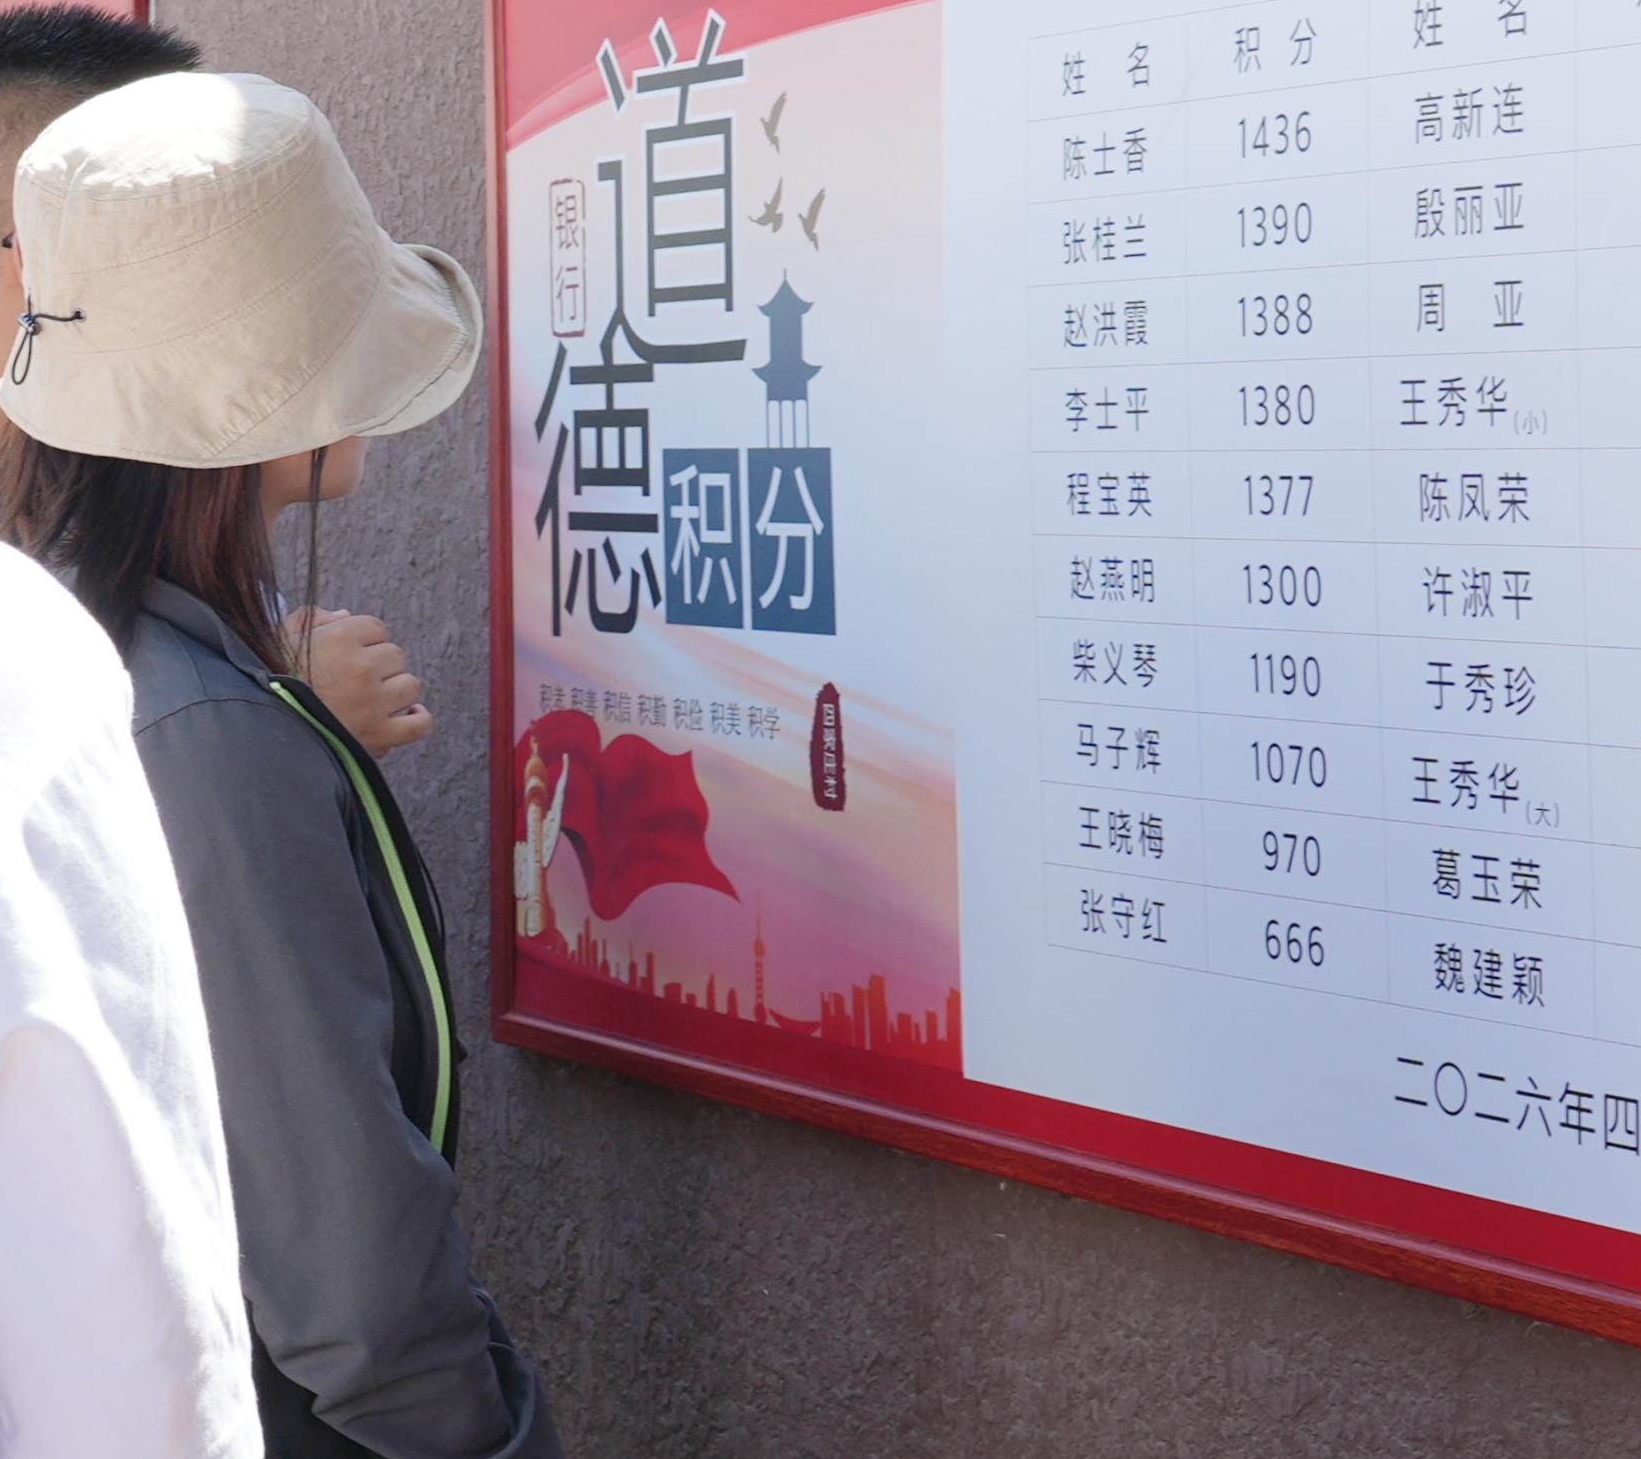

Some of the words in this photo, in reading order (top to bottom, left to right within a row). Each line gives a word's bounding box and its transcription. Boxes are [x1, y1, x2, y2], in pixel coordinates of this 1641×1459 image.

[1063, 127, 1148, 182] 陈士香
[1237, 110, 1312, 159] 1436
[1413, 82, 1525, 145] 高新连
[1062, 213, 1148, 265] 张桂兰
[1236, 201, 1313, 249] 1390
[1413, 181, 1525, 239] 殷丽亚
[1062, 299, 1149, 348] 赵洪霞
[1237, 292, 1314, 338] 1388
[1064, 386, 1150, 433] 李士平
[1238, 383, 1316, 427] 1380
[1066, 471, 1153, 518] 程宝英
[1243, 474, 1315, 517] 1377
[1418, 471, 1531, 524] 陈凤荣
[668, 464, 825, 610] 积分
[1069, 554, 1156, 604] 赵燕明
[1242, 563, 1323, 608] 1300
[1421, 565, 1534, 621] 许淑平
[1072, 638, 1159, 689] 柴义琴
[1249, 652, 1322, 698] 1190
[1424, 660, 1537, 717] 于秀珍
[709, 701, 743, 737] 积美
[747, 704, 781, 741] 积学
[1075, 722, 1162, 775] 马子辉
[1250, 740, 1328, 789] 1070
[1077, 806, 1165, 860] 王晓梅
[1262, 829, 1322, 878] 970
[1430, 846, 1543, 910] 葛玉荣
[1079, 888, 1169, 944] 张守红
[1264, 918, 1325, 968] 666
[1433, 942, 1546, 1008] 魏建颖
